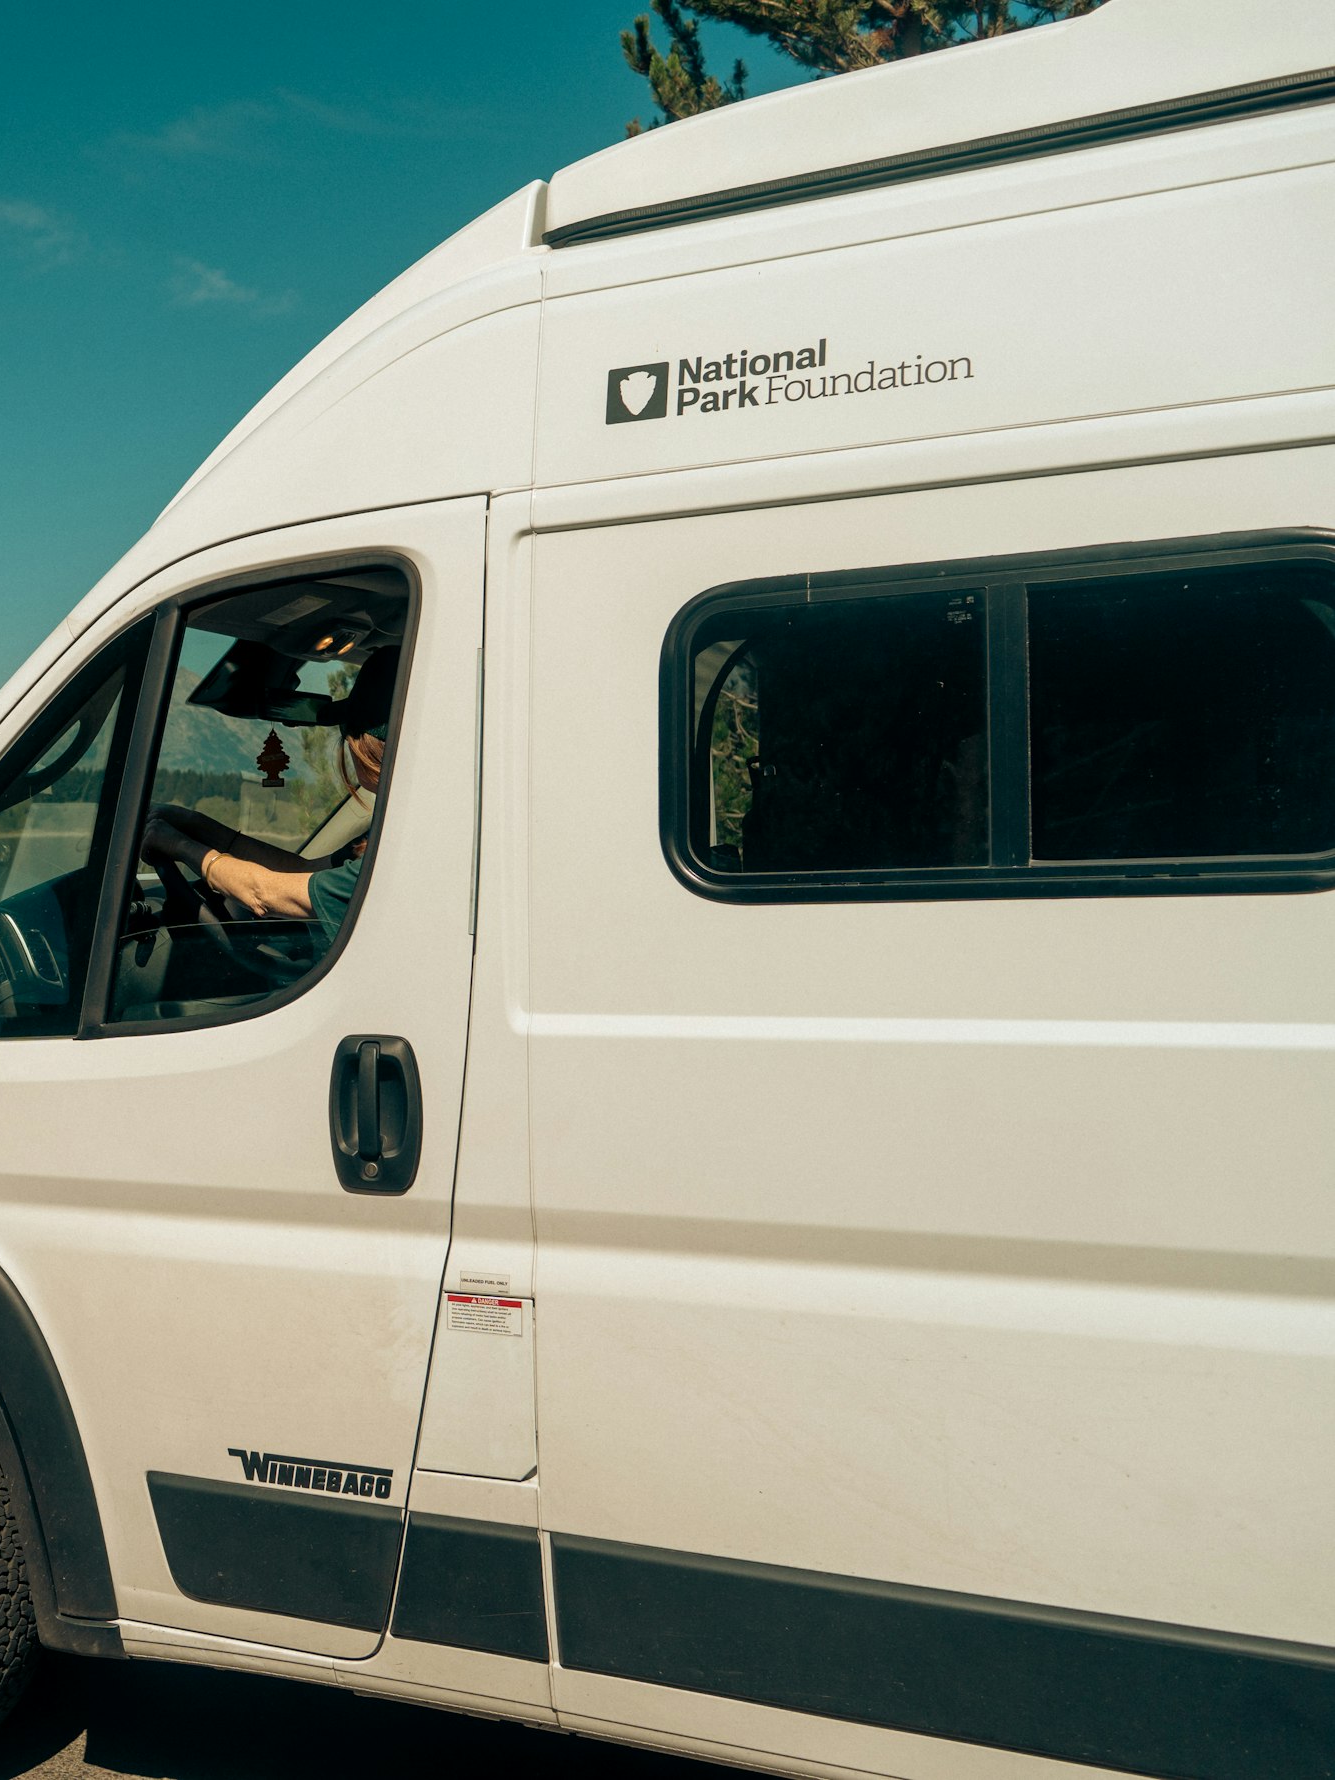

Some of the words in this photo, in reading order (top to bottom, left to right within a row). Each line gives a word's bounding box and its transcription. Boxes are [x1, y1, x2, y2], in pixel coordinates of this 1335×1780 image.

[677, 381, 759, 416] Park
[765, 354, 974, 405] Foundation
[678, 338, 826, 386] National
[477, 1298, 499, 1306] DANGER
[227, 1448, 393, 1499] WINNEBAGO
